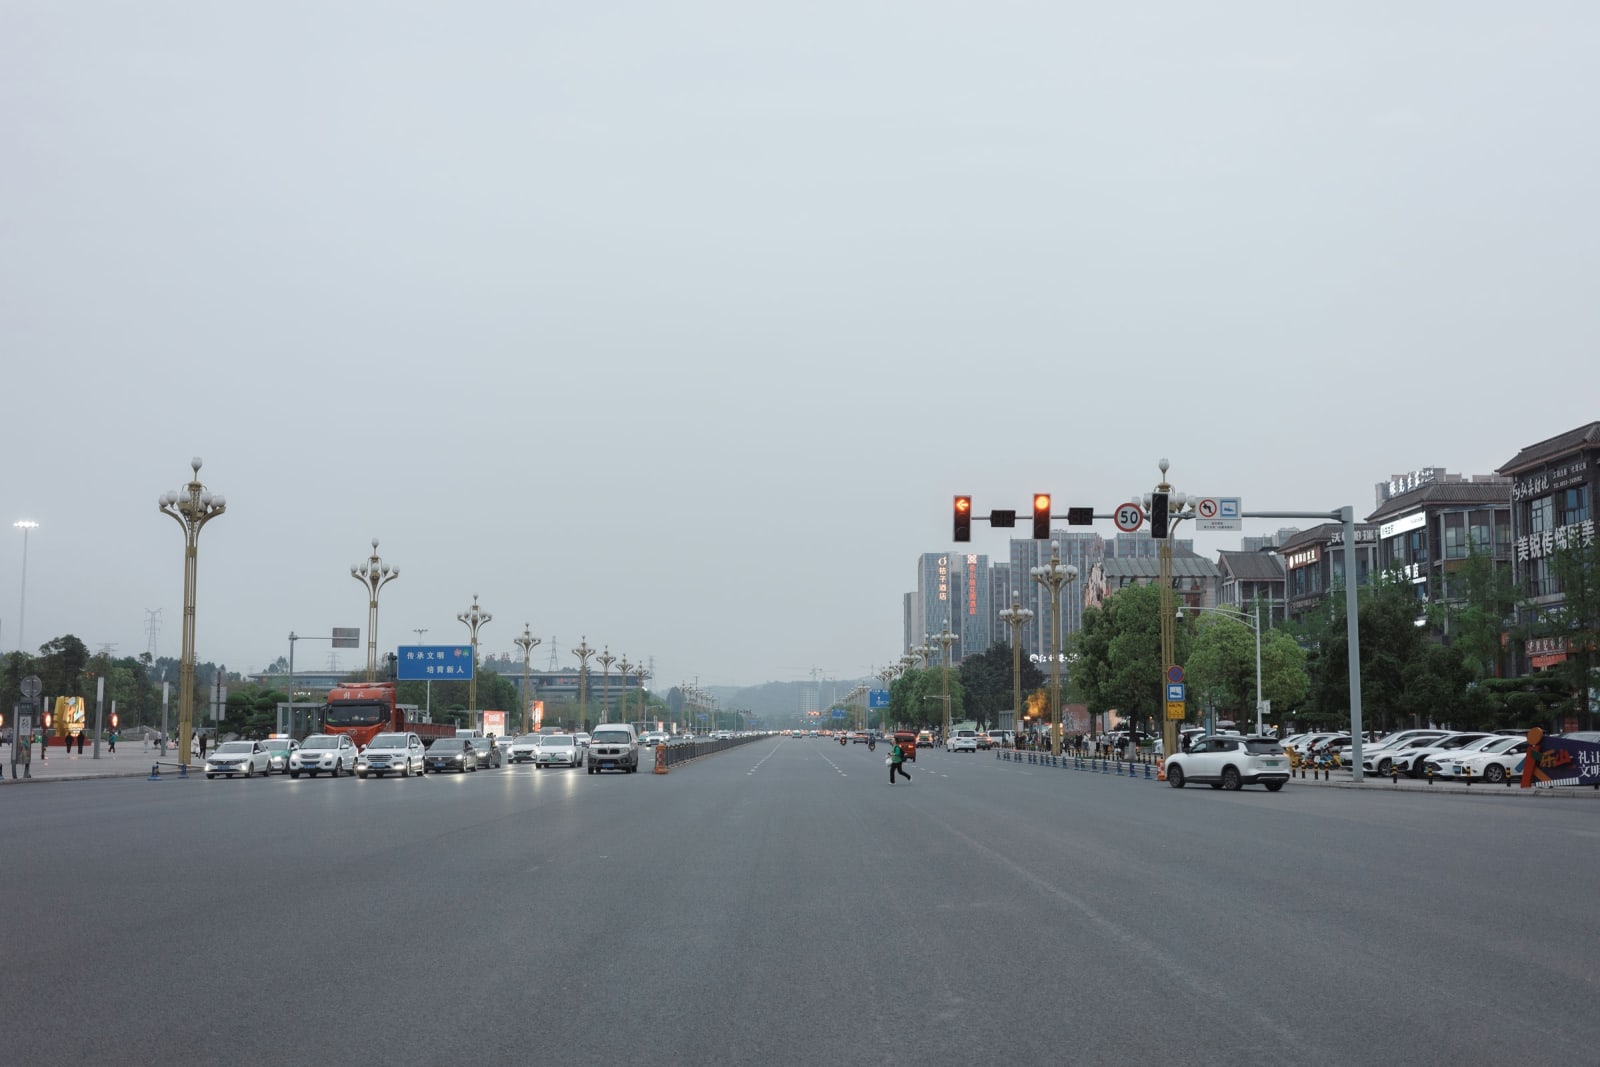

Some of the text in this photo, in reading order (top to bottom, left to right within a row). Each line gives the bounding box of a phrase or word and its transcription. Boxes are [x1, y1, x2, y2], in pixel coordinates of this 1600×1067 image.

[1120, 511, 1138, 524] 50
[407, 651, 444, 660] 传承文明
[427, 665, 464, 674] 培育新人
